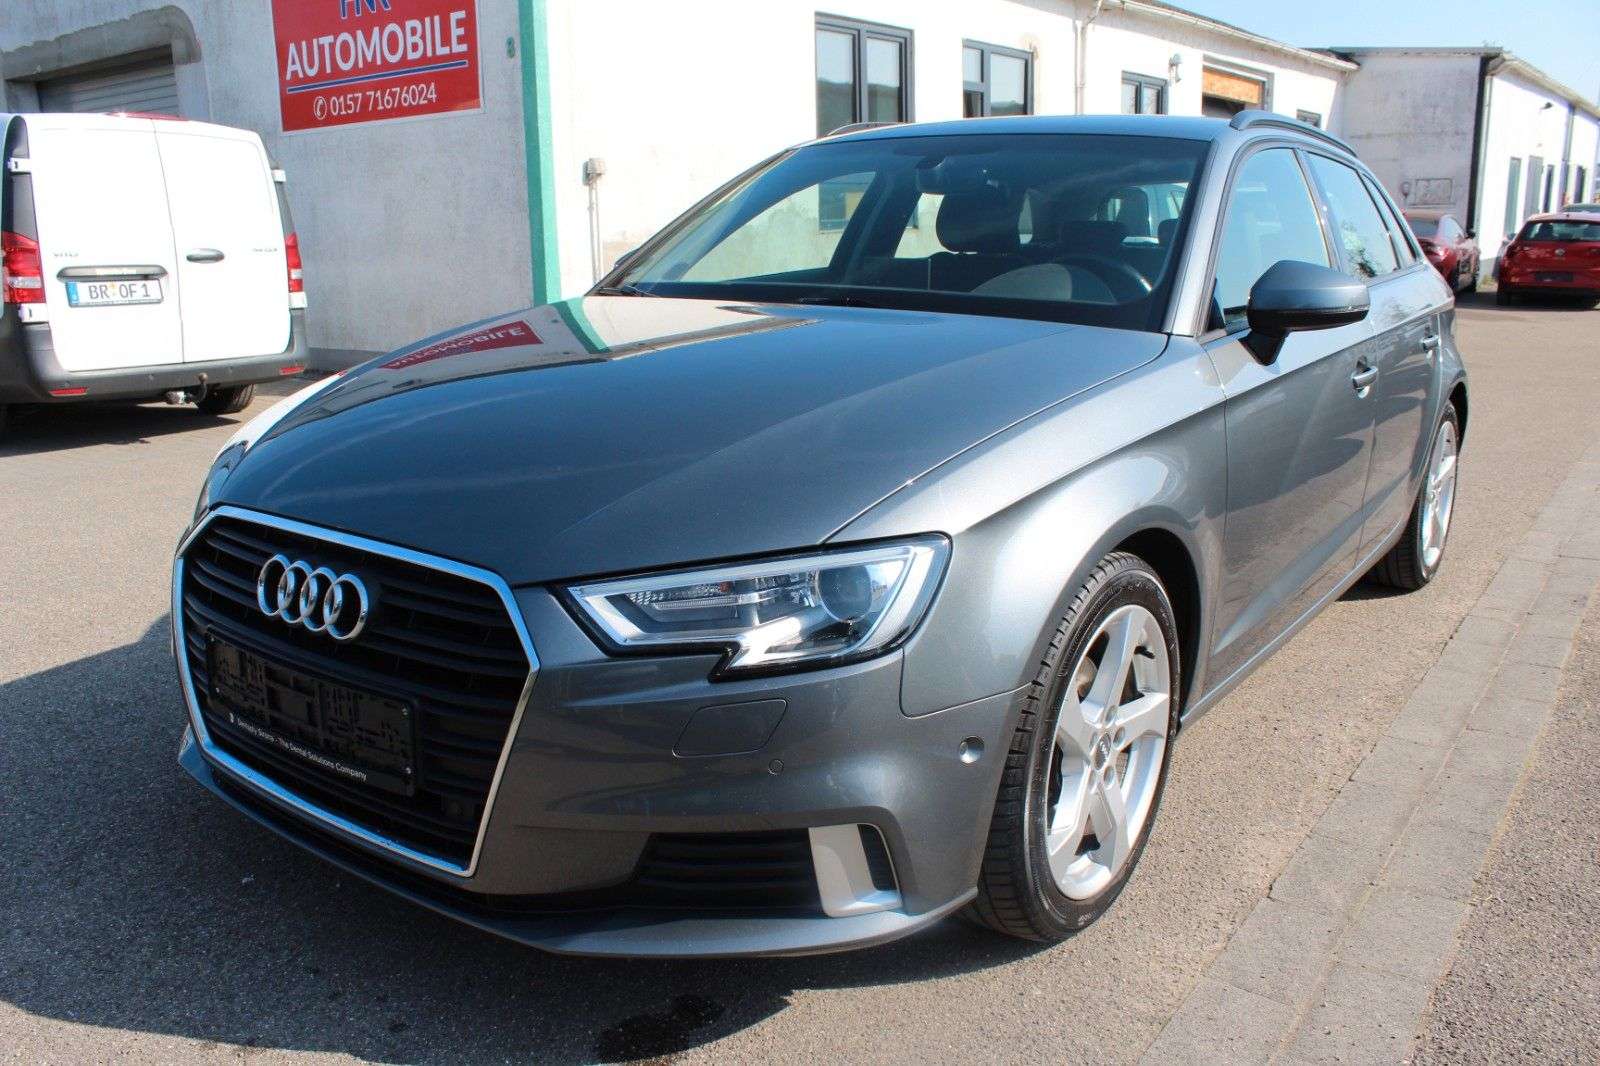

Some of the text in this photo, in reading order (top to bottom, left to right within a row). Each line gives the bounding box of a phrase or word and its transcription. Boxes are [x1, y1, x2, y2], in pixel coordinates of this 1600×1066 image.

[286, 11, 467, 80] AUTOMOBILE
[331, 84, 437, 116] 0157 71676024
[89, 284, 110, 299] BR
[142, 284, 151, 297] 1
[335, 762, 367, 781] Company
